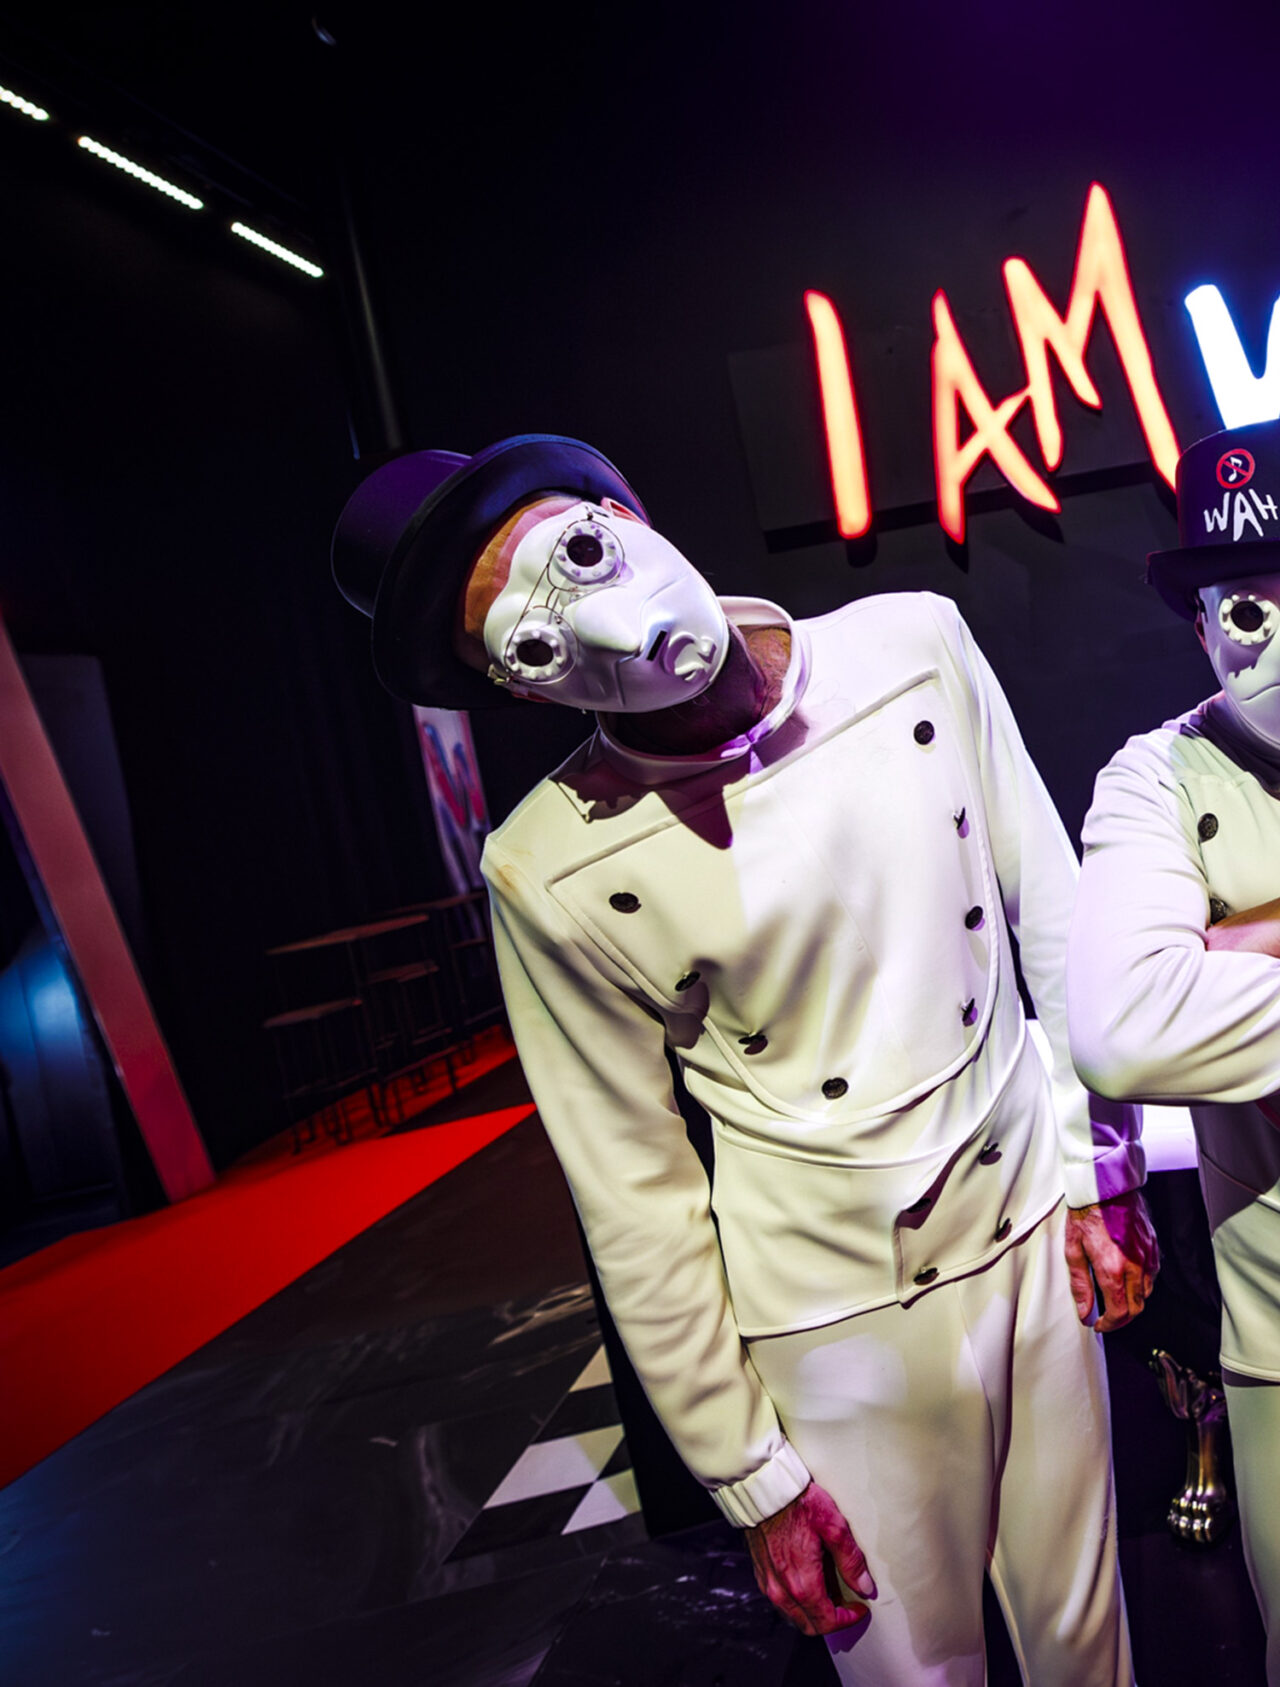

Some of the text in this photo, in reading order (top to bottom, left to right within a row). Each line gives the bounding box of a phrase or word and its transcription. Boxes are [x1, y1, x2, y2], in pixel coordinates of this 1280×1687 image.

[804, 289, 870, 539] I
[930, 180, 1182, 545] AM
[1203, 489, 1279, 542] WAH
